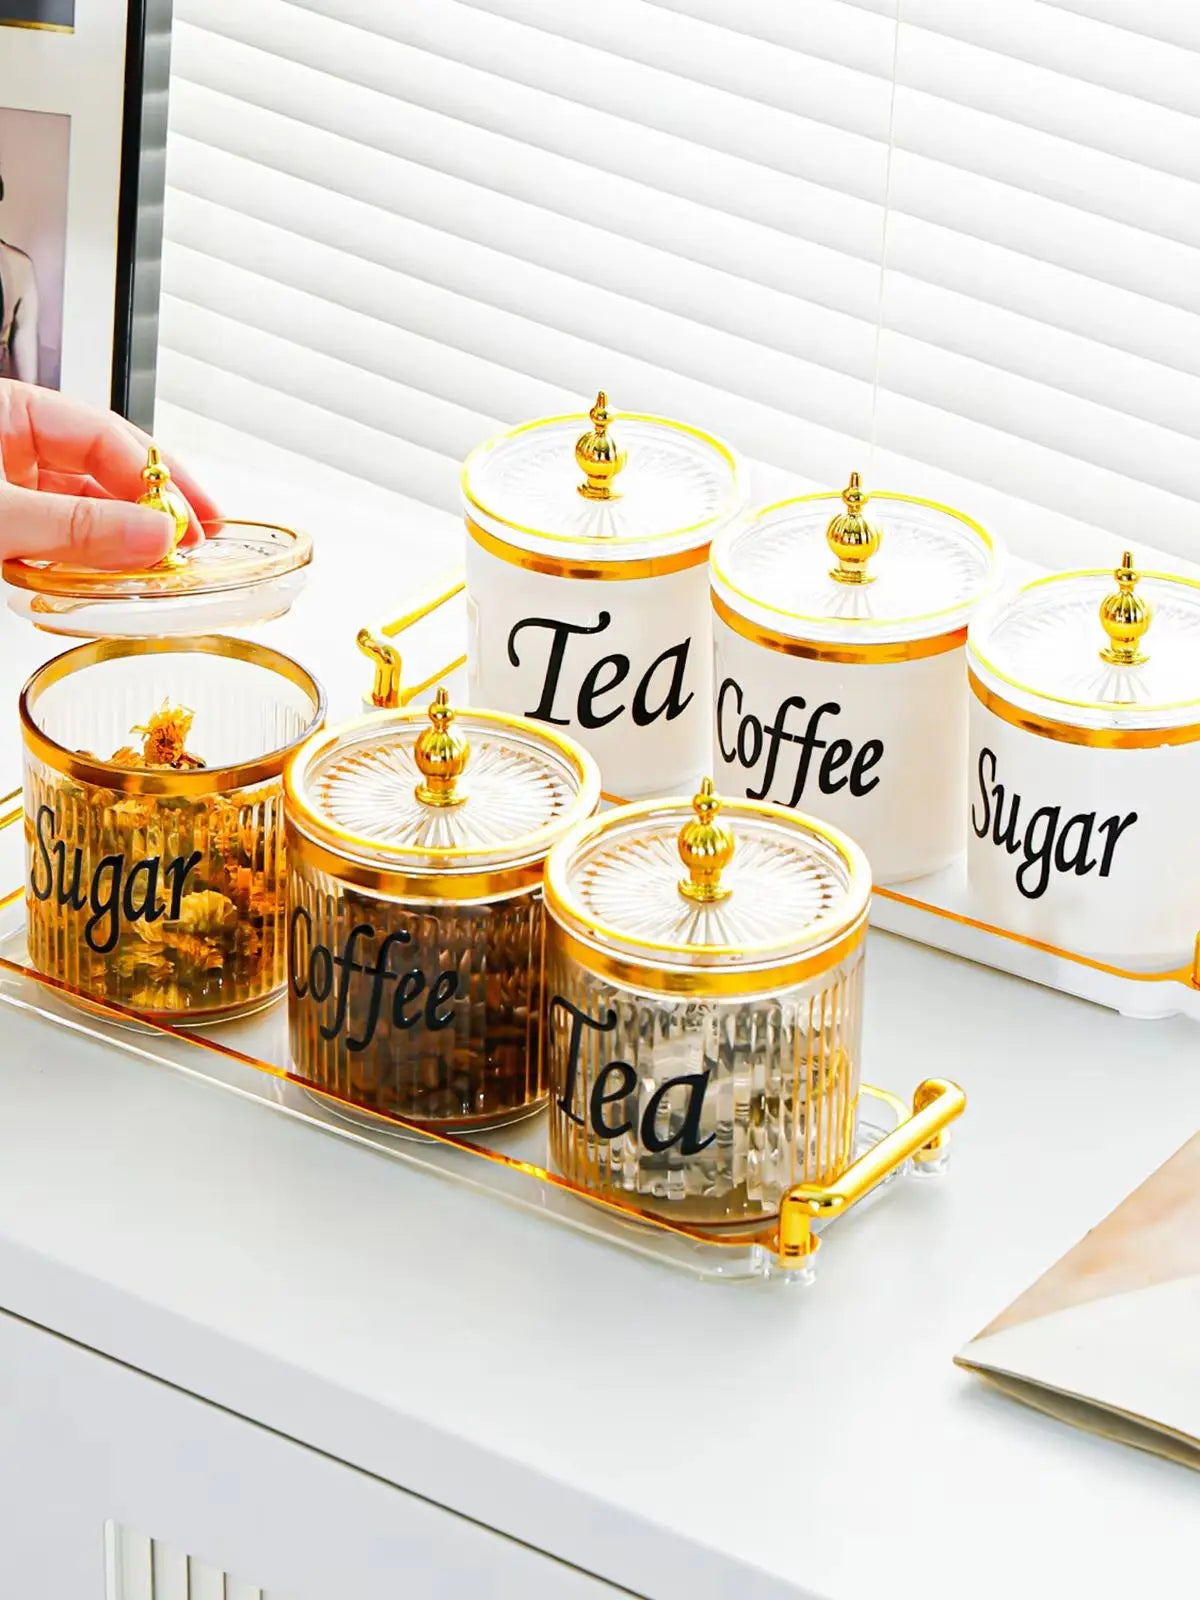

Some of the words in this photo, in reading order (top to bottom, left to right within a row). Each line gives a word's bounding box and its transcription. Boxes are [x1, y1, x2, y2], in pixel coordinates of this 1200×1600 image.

[508, 611, 694, 729] Tea
[717, 678, 884, 808] Coffee
[31, 804, 202, 953] Sugar
[972, 747, 1138, 899] Sugar
[291, 905, 458, 1051] Coffee
[551, 995, 717, 1155] Tea
